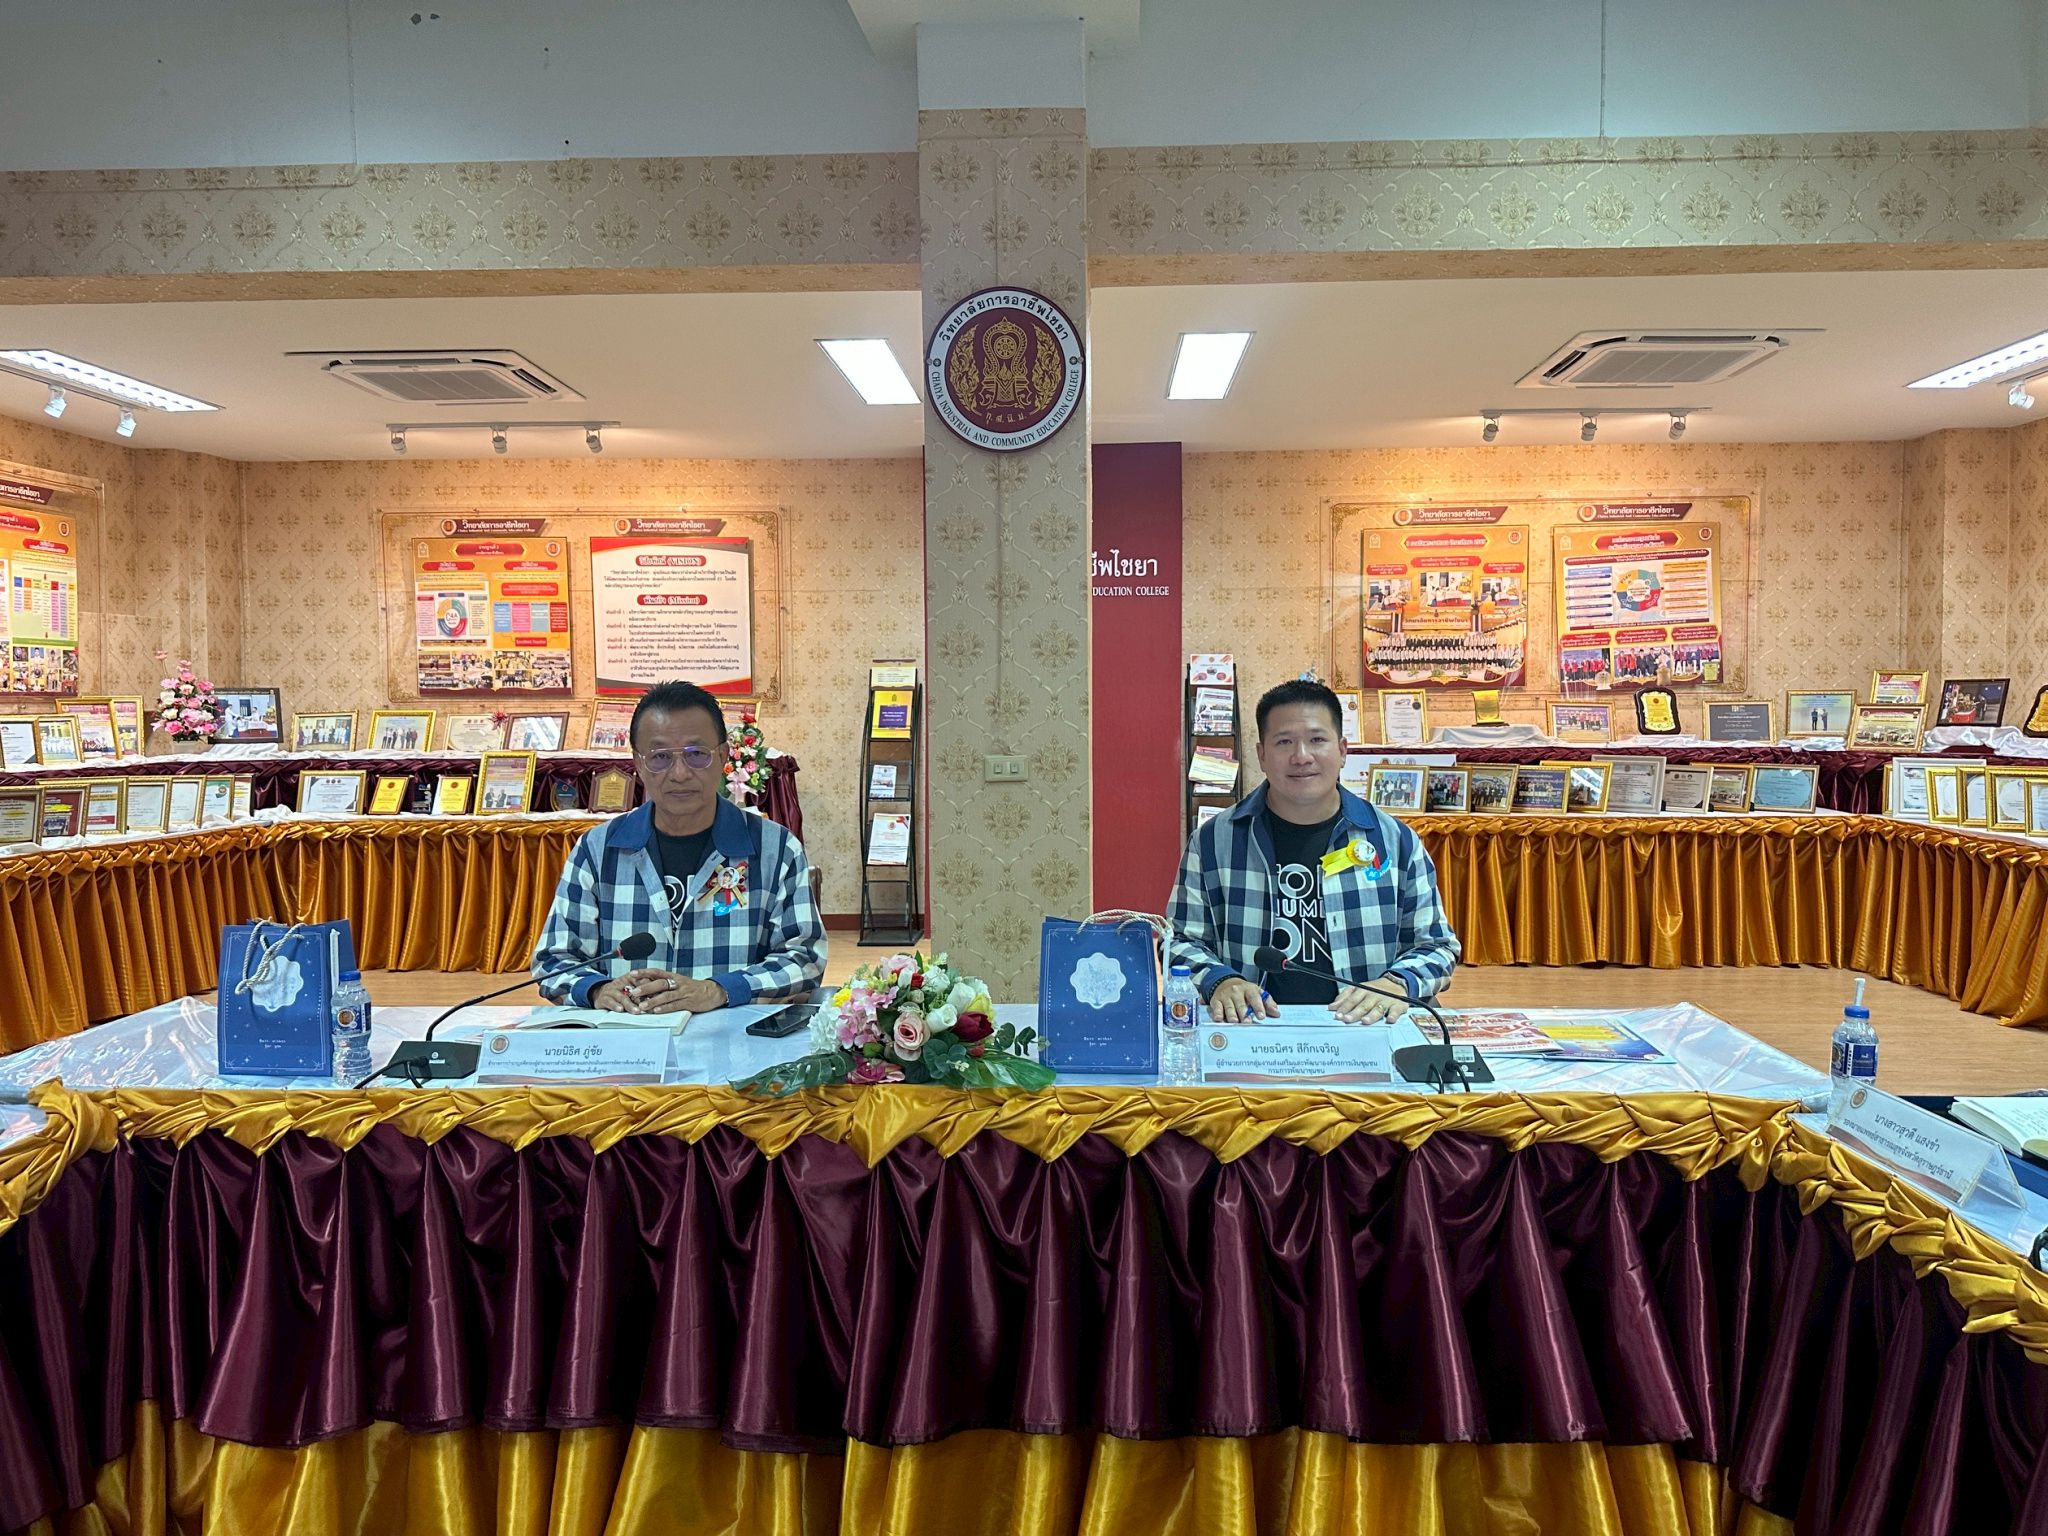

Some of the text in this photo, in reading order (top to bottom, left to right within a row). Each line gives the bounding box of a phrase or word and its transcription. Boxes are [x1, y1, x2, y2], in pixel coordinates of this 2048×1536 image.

[938, 295, 1069, 342] วิทยาลัยการอาชีพไชยา
[931, 369, 1080, 447] CHAIYA INDUSTRIAL AND COMMUNITY EDUCATION COLLEGE
[1418, 508, 1491, 518] วิทยาลัยการอาชีพไชยา
[1603, 505, 1675, 515] วิทยาลัยการอาชีพไชยา
[462, 519, 530, 529] วิทยาลัยการอาชีพไชยา
[636, 518, 706, 529] วิทยาลัยการอาชีพไชยา
[1092, 586, 1170, 597] DUCATION COLLEGE
[667, 595, 701, 605] (Mission)
[583, 1044, 603, 1059] ภู่ชัย
